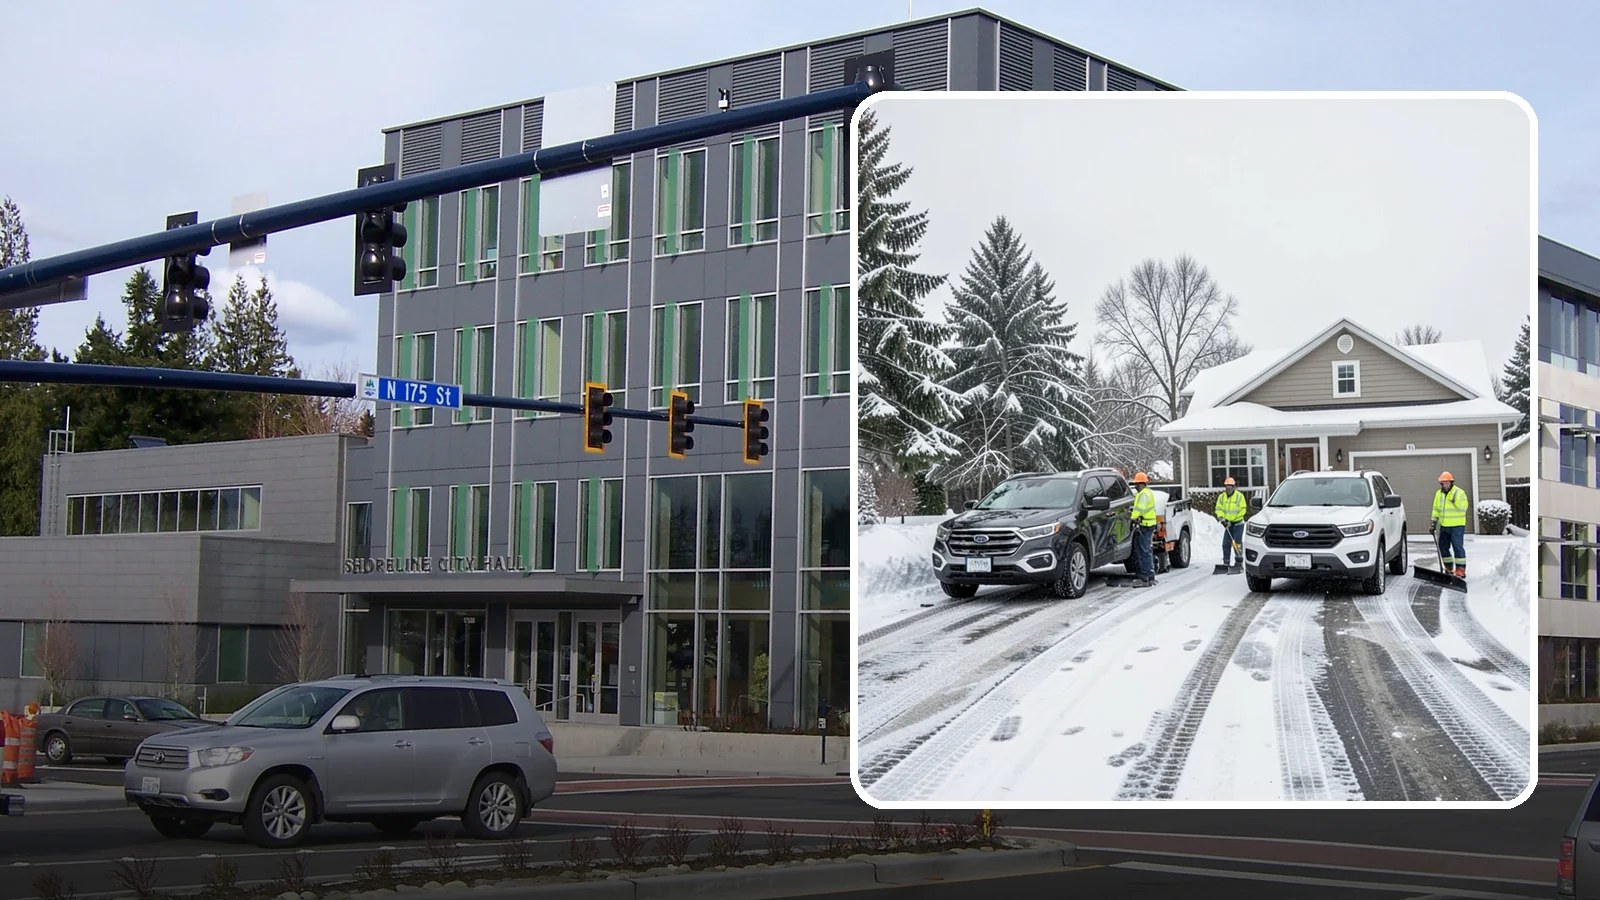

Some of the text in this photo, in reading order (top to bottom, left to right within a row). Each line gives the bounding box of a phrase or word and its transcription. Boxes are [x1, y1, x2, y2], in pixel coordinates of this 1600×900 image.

[387, 380, 451, 406] N 175 St
[344, 555, 525, 574] SHORELINE CITY HALL
